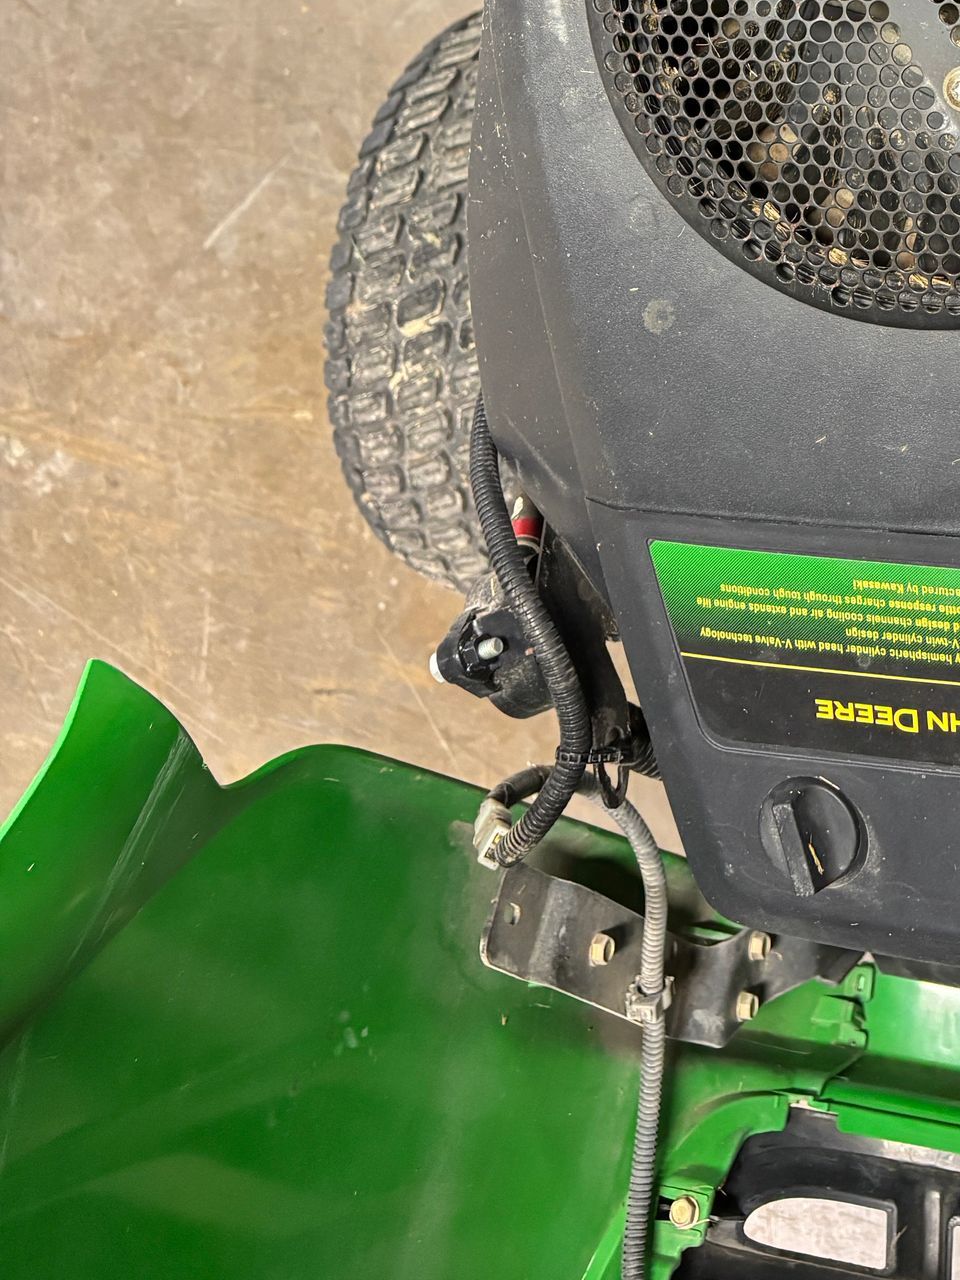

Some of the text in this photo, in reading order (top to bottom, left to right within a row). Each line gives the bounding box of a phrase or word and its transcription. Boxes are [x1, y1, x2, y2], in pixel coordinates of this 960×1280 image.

[720, 584, 769, 598] conditions
[853, 580, 904, 593] Kawasaki
[907, 583, 918, 595] by
[773, 588, 801, 602] tough
[804, 591, 842, 605] through
[696, 597, 711, 608] life
[714, 598, 746, 610] engine
[749, 602, 786, 614] extends
[845, 596, 885, 609] charges
[889, 599, 936, 613] response
[790, 607, 808, 617] and
[812, 609, 823, 619] air
[827, 609, 864, 623] cooling
[866, 614, 912, 628] channels
[915, 618, 950, 631] design
[700, 627, 752, 643] technology
[846, 628, 879, 641] design
[882, 631, 922, 644] cylinder
[755, 635, 792, 648] V-Valve
[795, 639, 816, 650] with
[819, 642, 843, 654] head
[926, 636, 959, 649] V-twin
[845, 644, 886, 657] cylinder
[890, 648, 952, 664] hemispheric
[815, 699, 918, 733] DEERE
